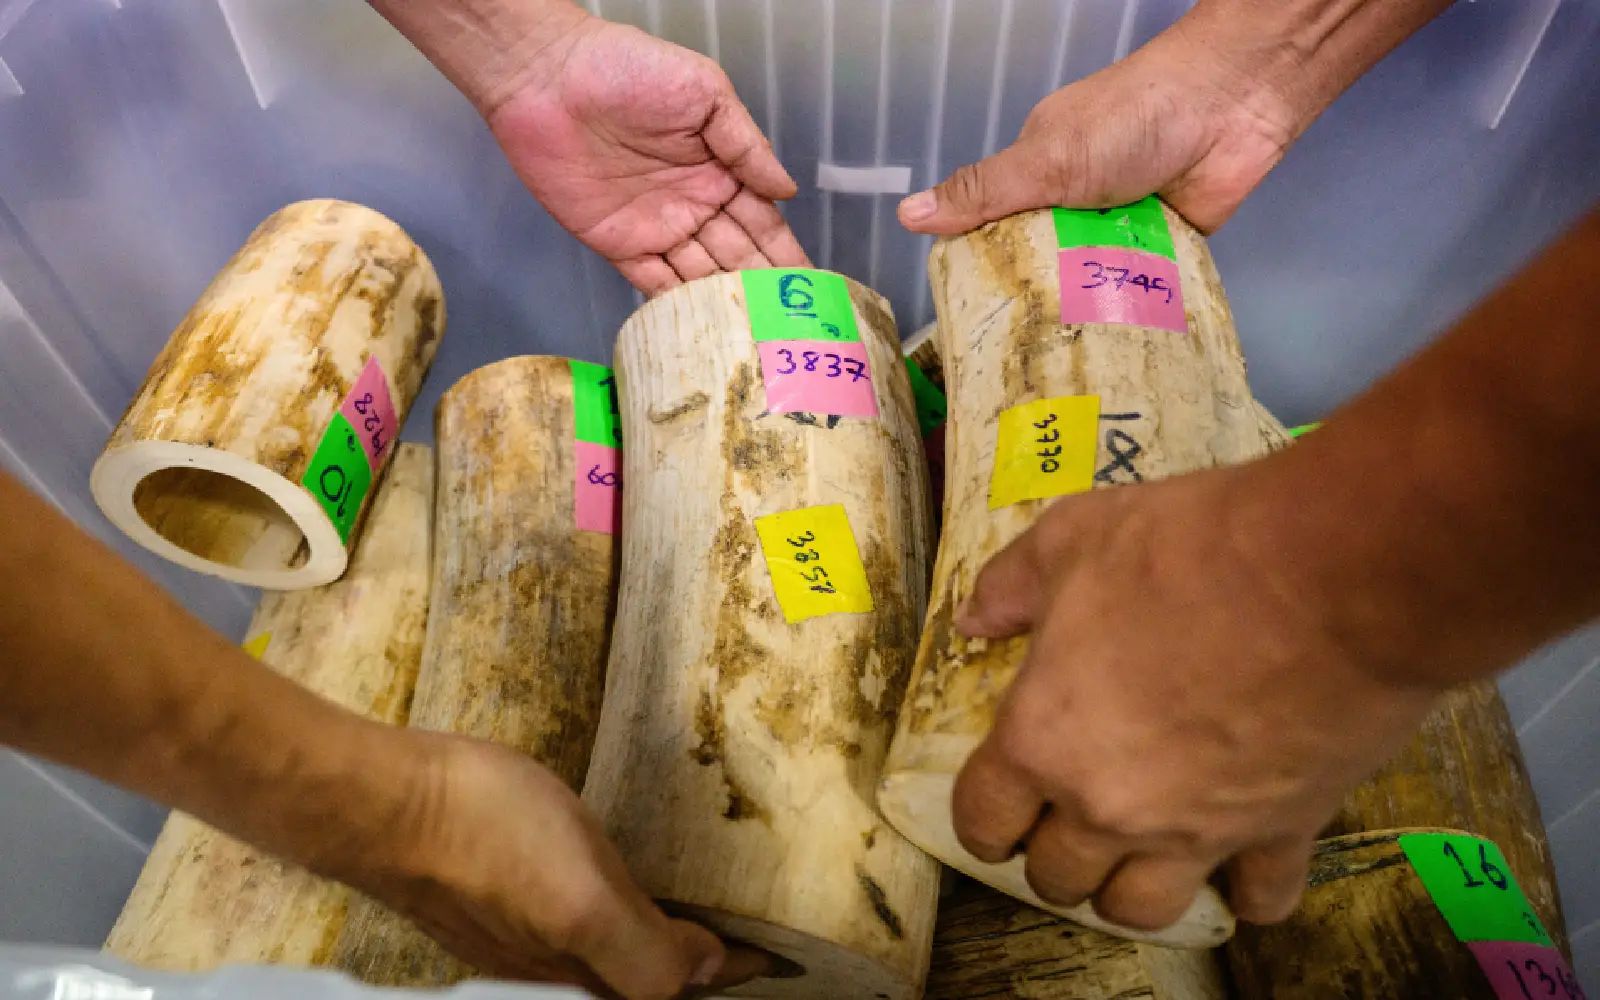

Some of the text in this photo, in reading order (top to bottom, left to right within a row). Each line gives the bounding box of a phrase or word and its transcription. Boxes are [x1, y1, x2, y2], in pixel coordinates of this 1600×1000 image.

[776, 348, 871, 382] 3837
[1032, 413, 1062, 473] 3770
[1443, 841, 1508, 891] 16
